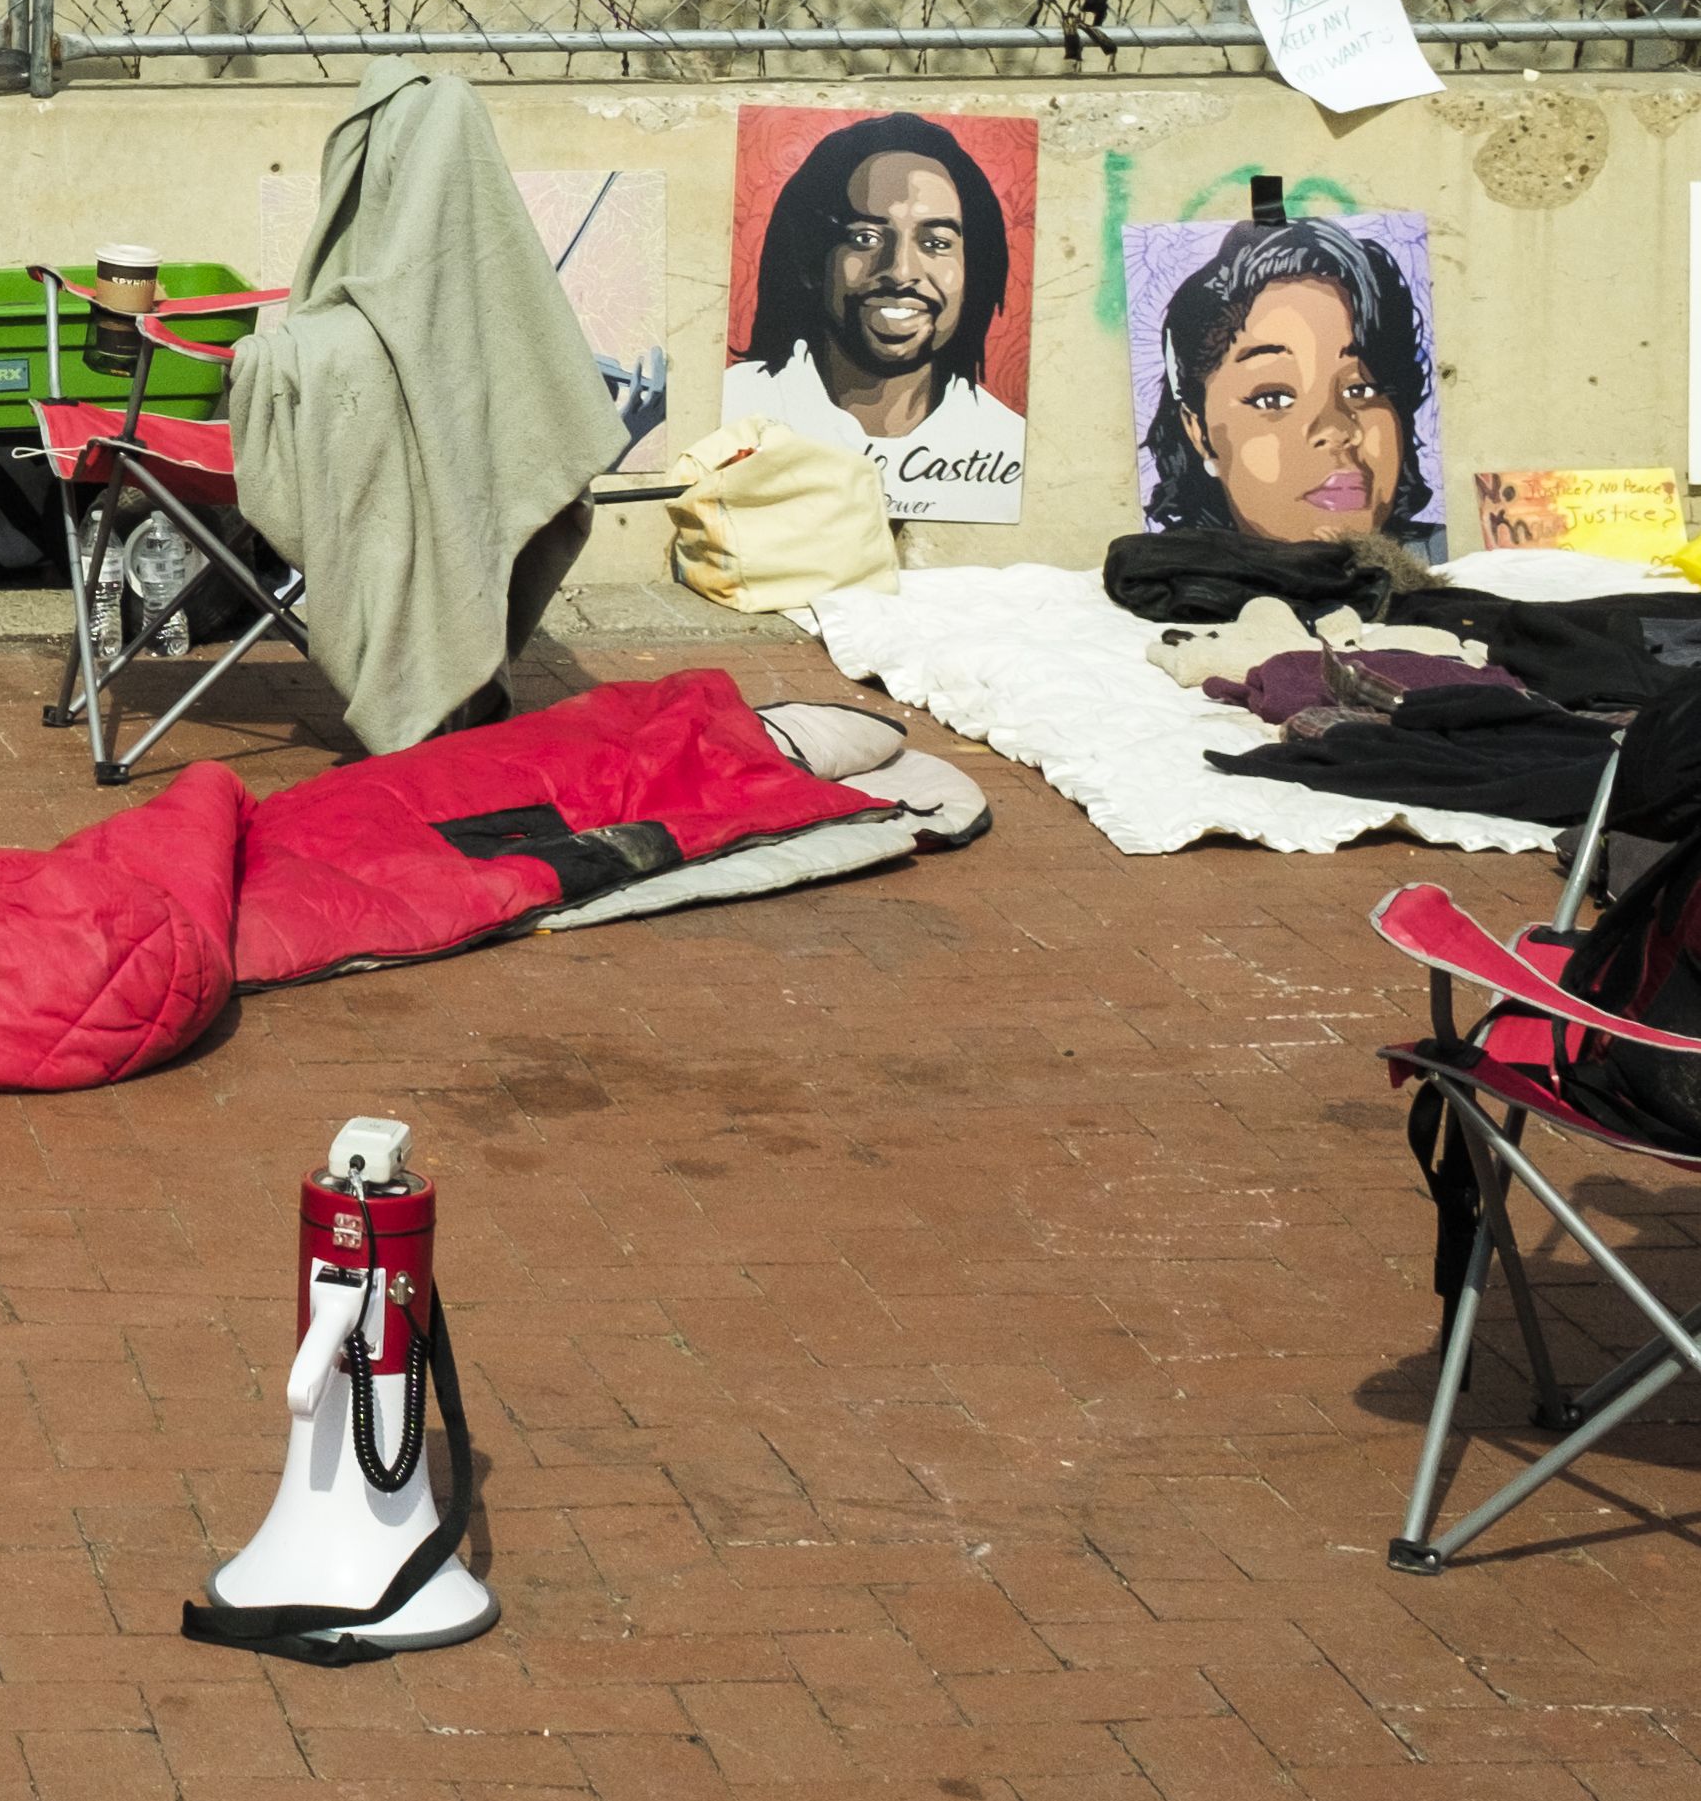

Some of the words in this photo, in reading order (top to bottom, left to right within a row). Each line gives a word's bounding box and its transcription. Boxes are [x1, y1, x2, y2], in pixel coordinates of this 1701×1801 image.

[1324, 5, 1351, 38] ANY
[1325, 31, 1372, 69] WANT
[899, 446, 1022, 484] Castile
[1523, 477, 1594, 499] Justice?
[1565, 506, 1676, 532] Justice?
